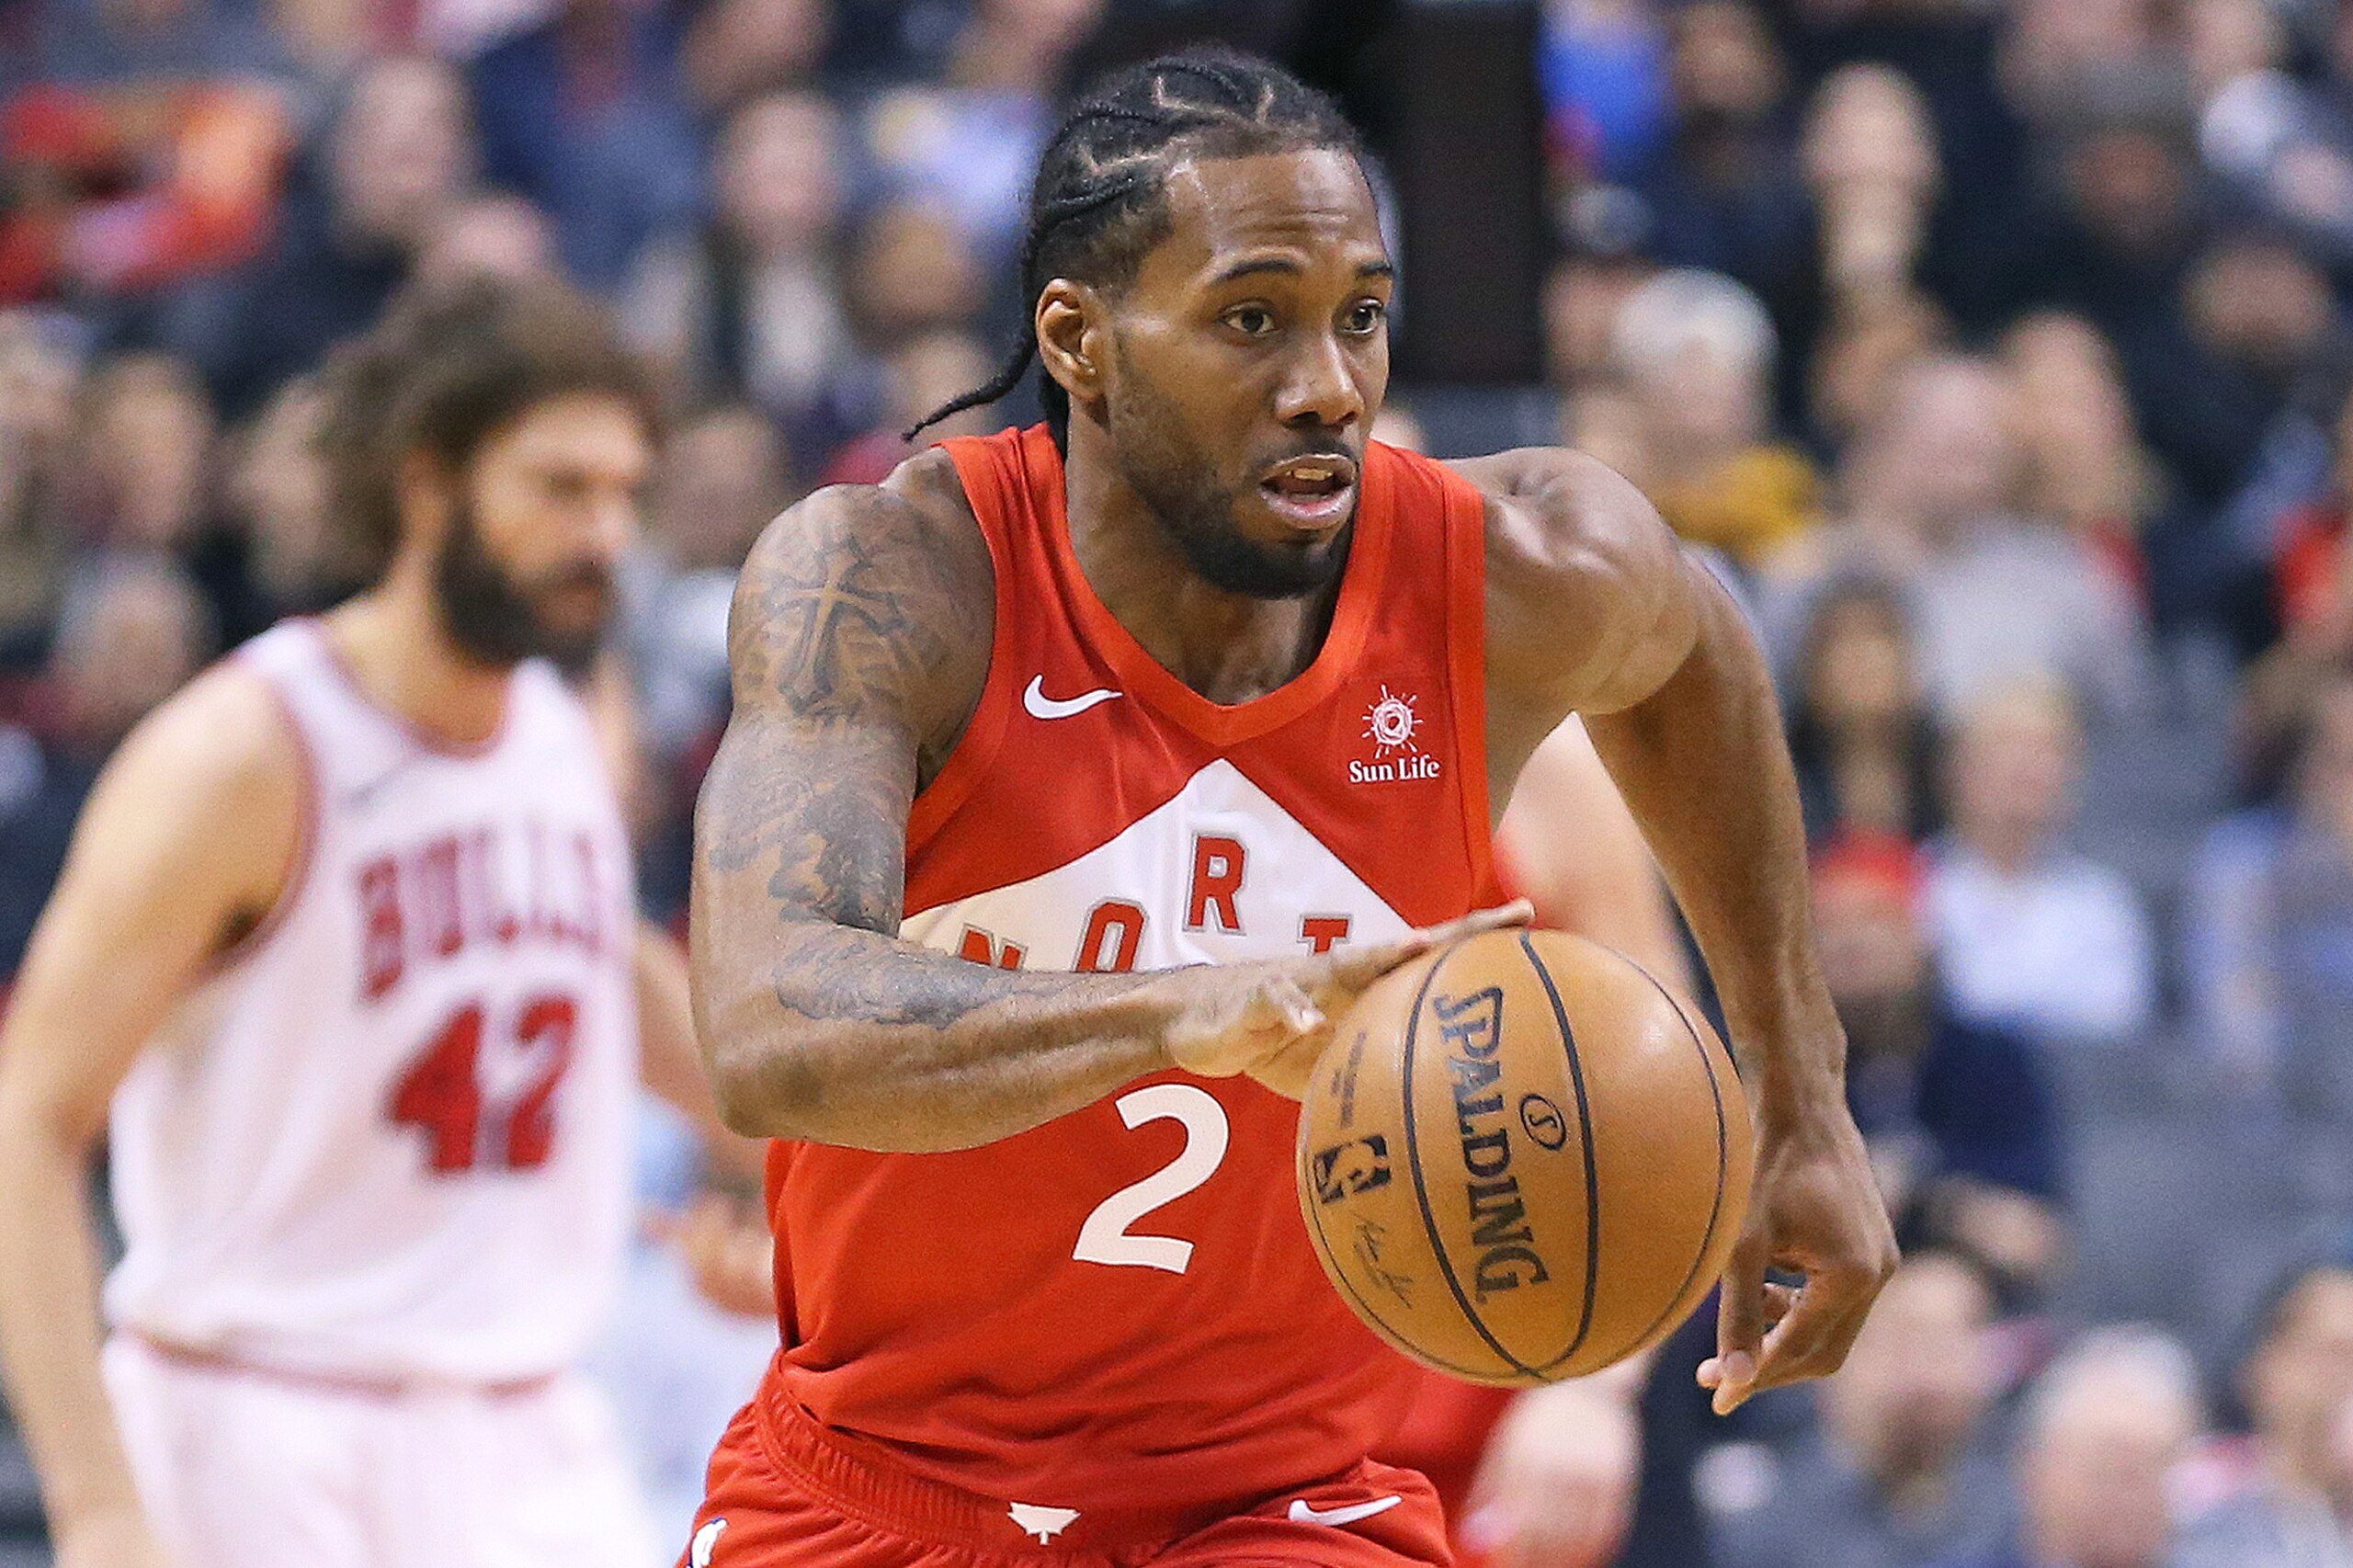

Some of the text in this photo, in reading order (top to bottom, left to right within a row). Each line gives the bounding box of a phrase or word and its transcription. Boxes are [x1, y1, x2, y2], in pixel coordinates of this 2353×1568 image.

[1348, 754, 1440, 783] Sun Life
[384, 990, 586, 1177] 42
[1433, 987, 1550, 1303] SPALDING
[1072, 1084, 1230, 1274] 2
